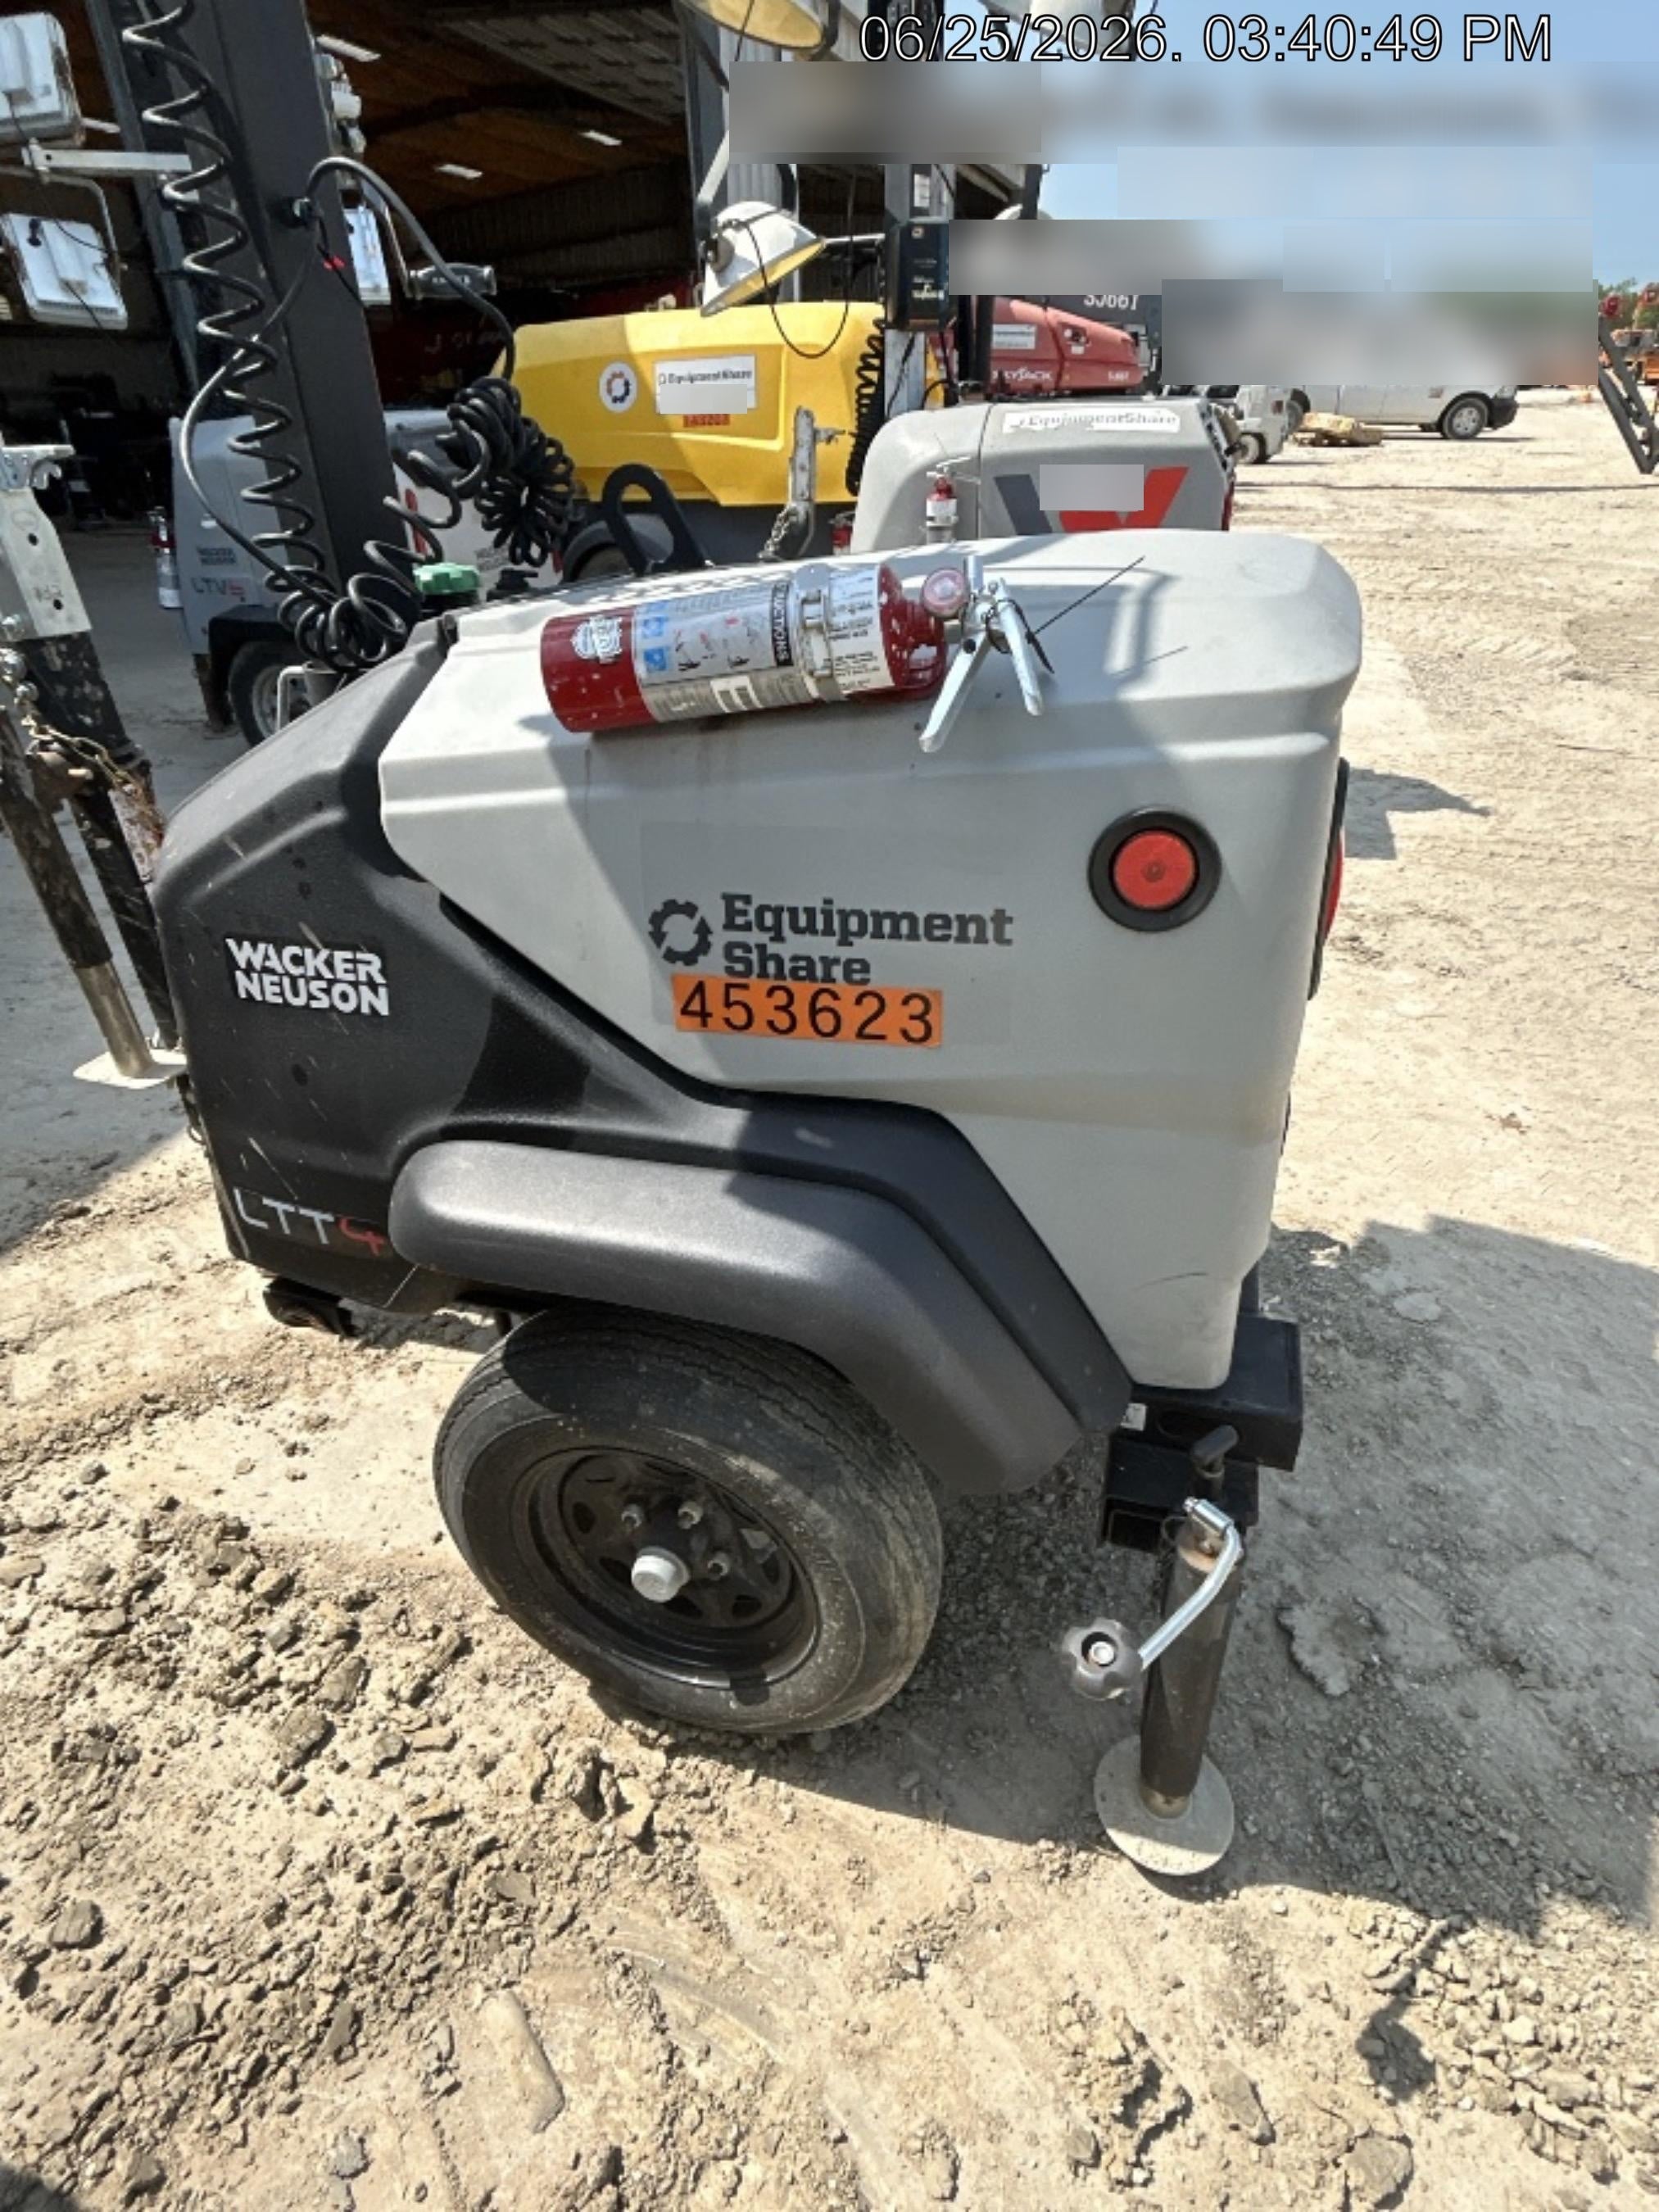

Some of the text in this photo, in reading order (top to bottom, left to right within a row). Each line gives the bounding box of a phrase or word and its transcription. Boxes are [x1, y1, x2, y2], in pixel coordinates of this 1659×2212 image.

[721, 892, 1013, 946] Equipment
[224, 937, 388, 984] WACKER
[723, 941, 871, 985] Share
[234, 970, 390, 1017] NEUSON
[680, 980, 933, 1045] 453623
[233, 1186, 387, 1258] LTT4
